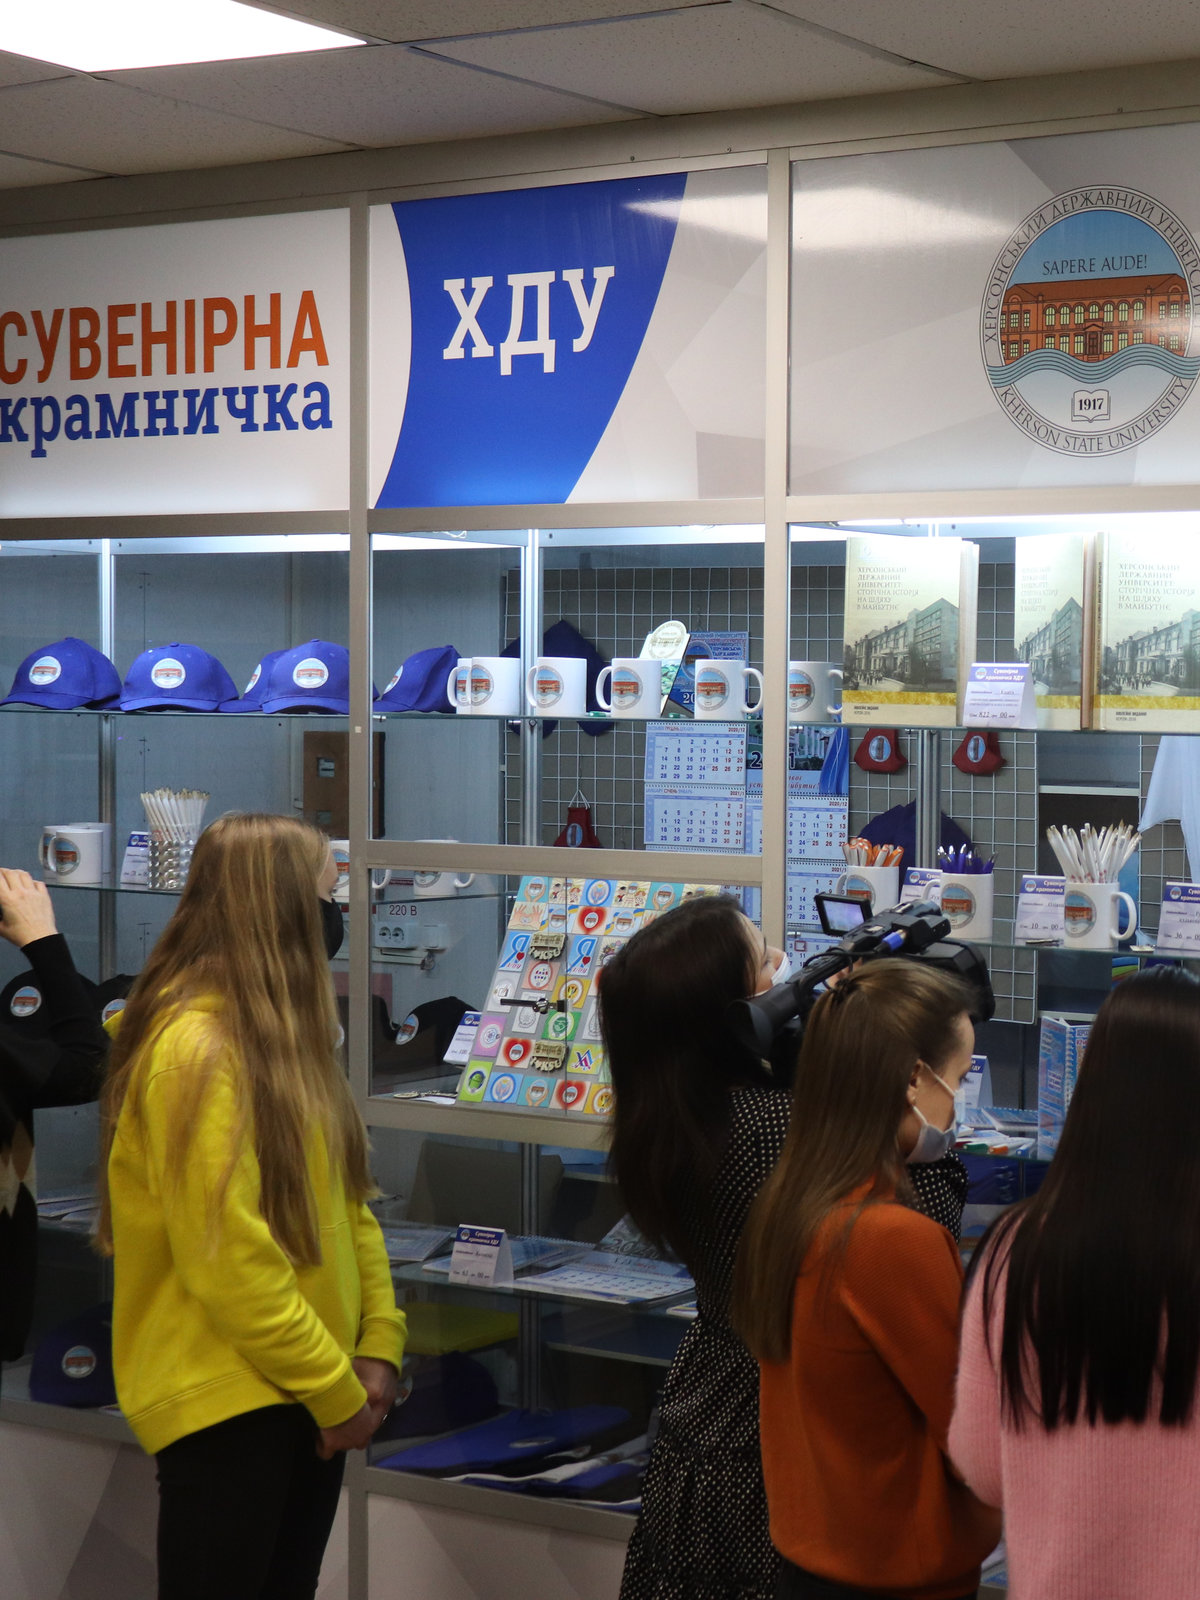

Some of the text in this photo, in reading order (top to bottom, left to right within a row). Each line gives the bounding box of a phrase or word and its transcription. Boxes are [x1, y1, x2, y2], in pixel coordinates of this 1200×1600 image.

[984, 213, 1049, 343] ХЕРСОНСЬКИЙ
[1051, 190, 1155, 219] ДЕРЖАВНИЙ
[1042, 254, 1148, 276] SAPERE AUDE!
[0, 289, 330, 385] СУВЕНІРНА
[442, 265, 616, 376] ХДУ
[0, 380, 333, 458] крамничка
[1000, 379, 1189, 452] KHERSON STATE UNIVERSITY
[1077, 397, 1104, 412] 1917
[389, 904, 407, 916] 220
